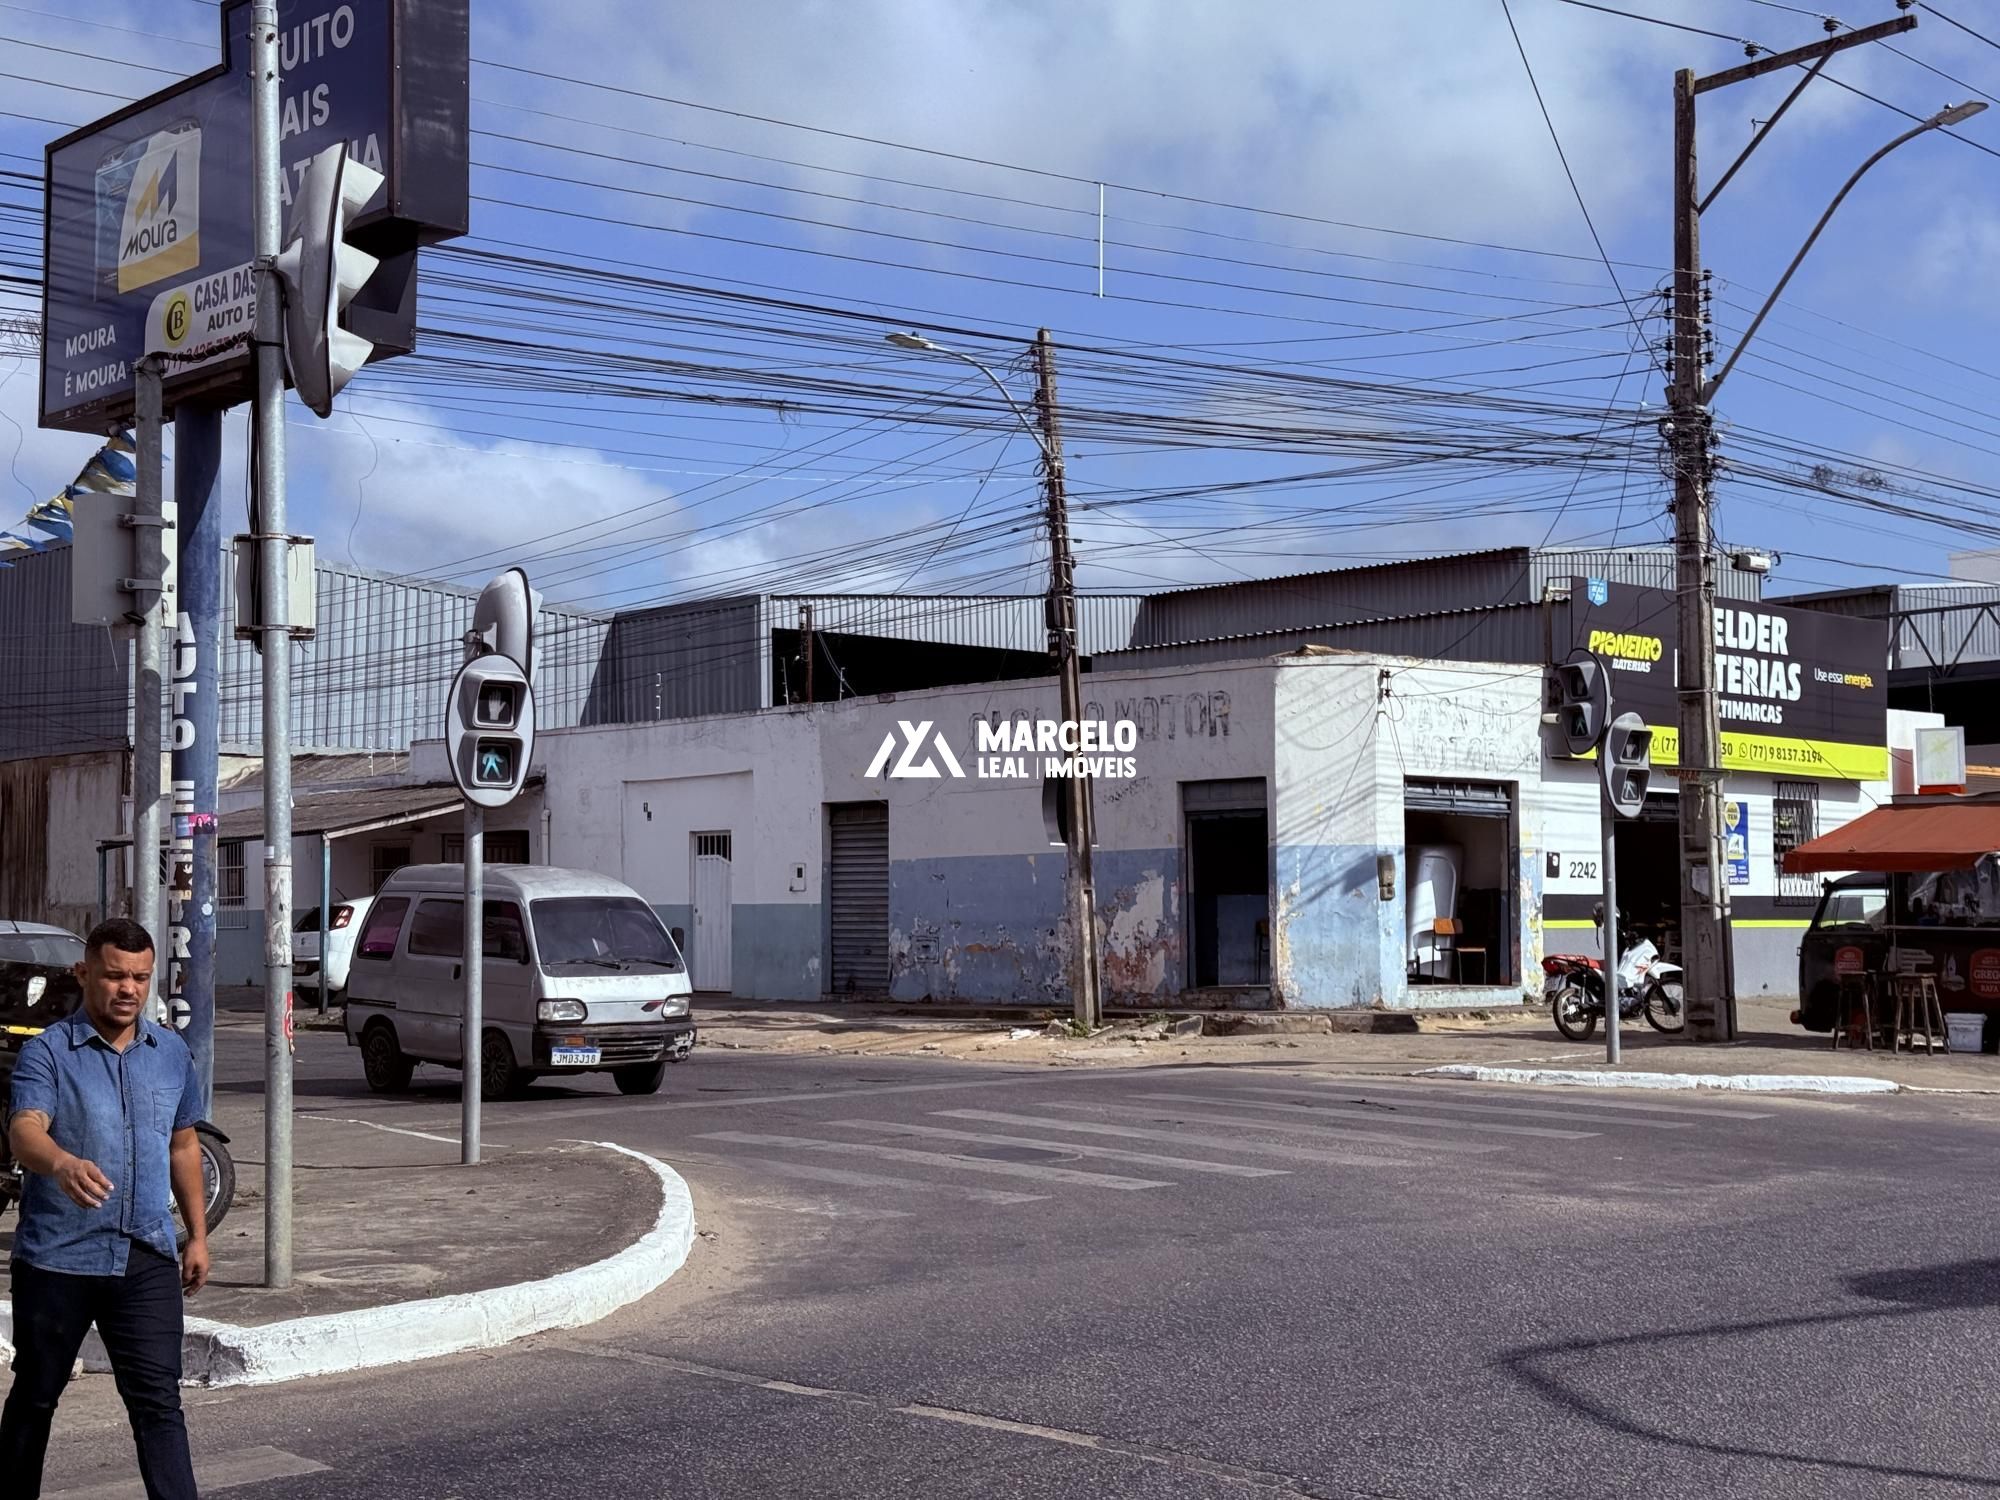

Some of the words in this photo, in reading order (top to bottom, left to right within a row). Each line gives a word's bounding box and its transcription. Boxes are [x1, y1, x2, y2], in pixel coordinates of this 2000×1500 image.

[281, 5, 354, 71] UITO
[281, 83, 330, 140] AIS
[194, 276, 229, 312] CASA
[233, 268, 256, 301] DAS
[207, 305, 243, 332] AUTO
[65, 325, 116, 358] MOURA
[64, 371, 72, 397] É
[75, 361, 127, 394] MOURA
[1588, 630, 1662, 661] PIONEIRO
[1714, 607, 1789, 656] ELDER
[172, 611, 197, 750] AUTO
[1612, 658, 1652, 673] BATERIAS
[1714, 653, 1802, 701] TERIAS
[1814, 668, 1827, 682] Use
[1828, 672, 1843, 685] essa
[1844, 675, 1874, 690] energia.
[1115, 690, 1231, 740] MOTOR
[1719, 699, 1783, 725] TIMARCAS
[1749, 743, 1767, 761] (77)
[1570, 861, 1597, 879] 2242
